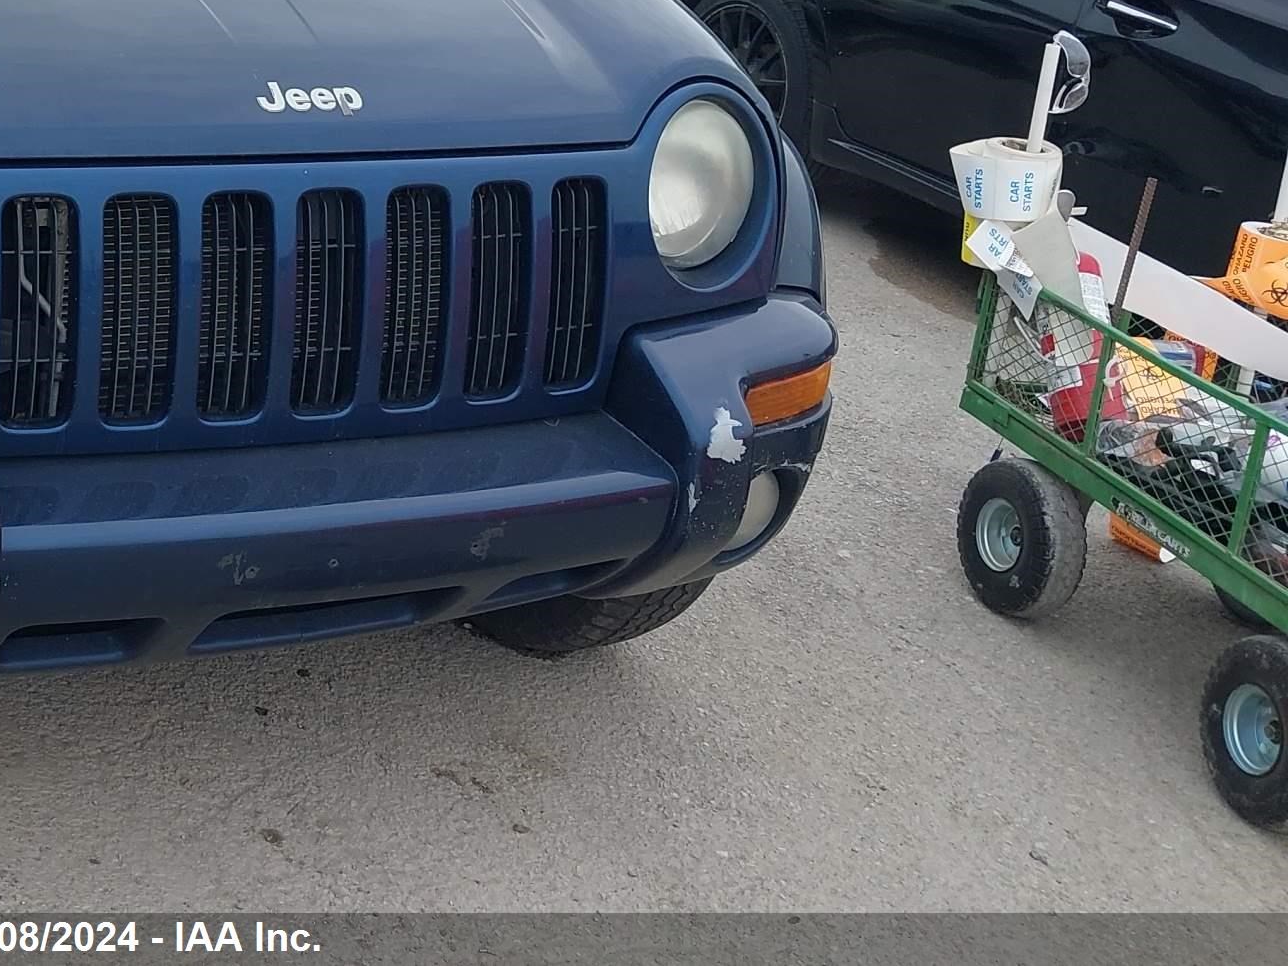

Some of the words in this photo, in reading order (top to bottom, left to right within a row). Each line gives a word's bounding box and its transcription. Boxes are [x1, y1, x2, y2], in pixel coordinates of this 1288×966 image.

[256, 81, 363, 116] Jeep
[974, 168, 984, 209] STARTS
[1009, 181, 1020, 203] CAR
[1022, 172, 1035, 212] STARTS
[989, 227, 1007, 248] RTS
[987, 242, 1002, 259] AR
[1232, 278, 1252, 302] LIGRO
